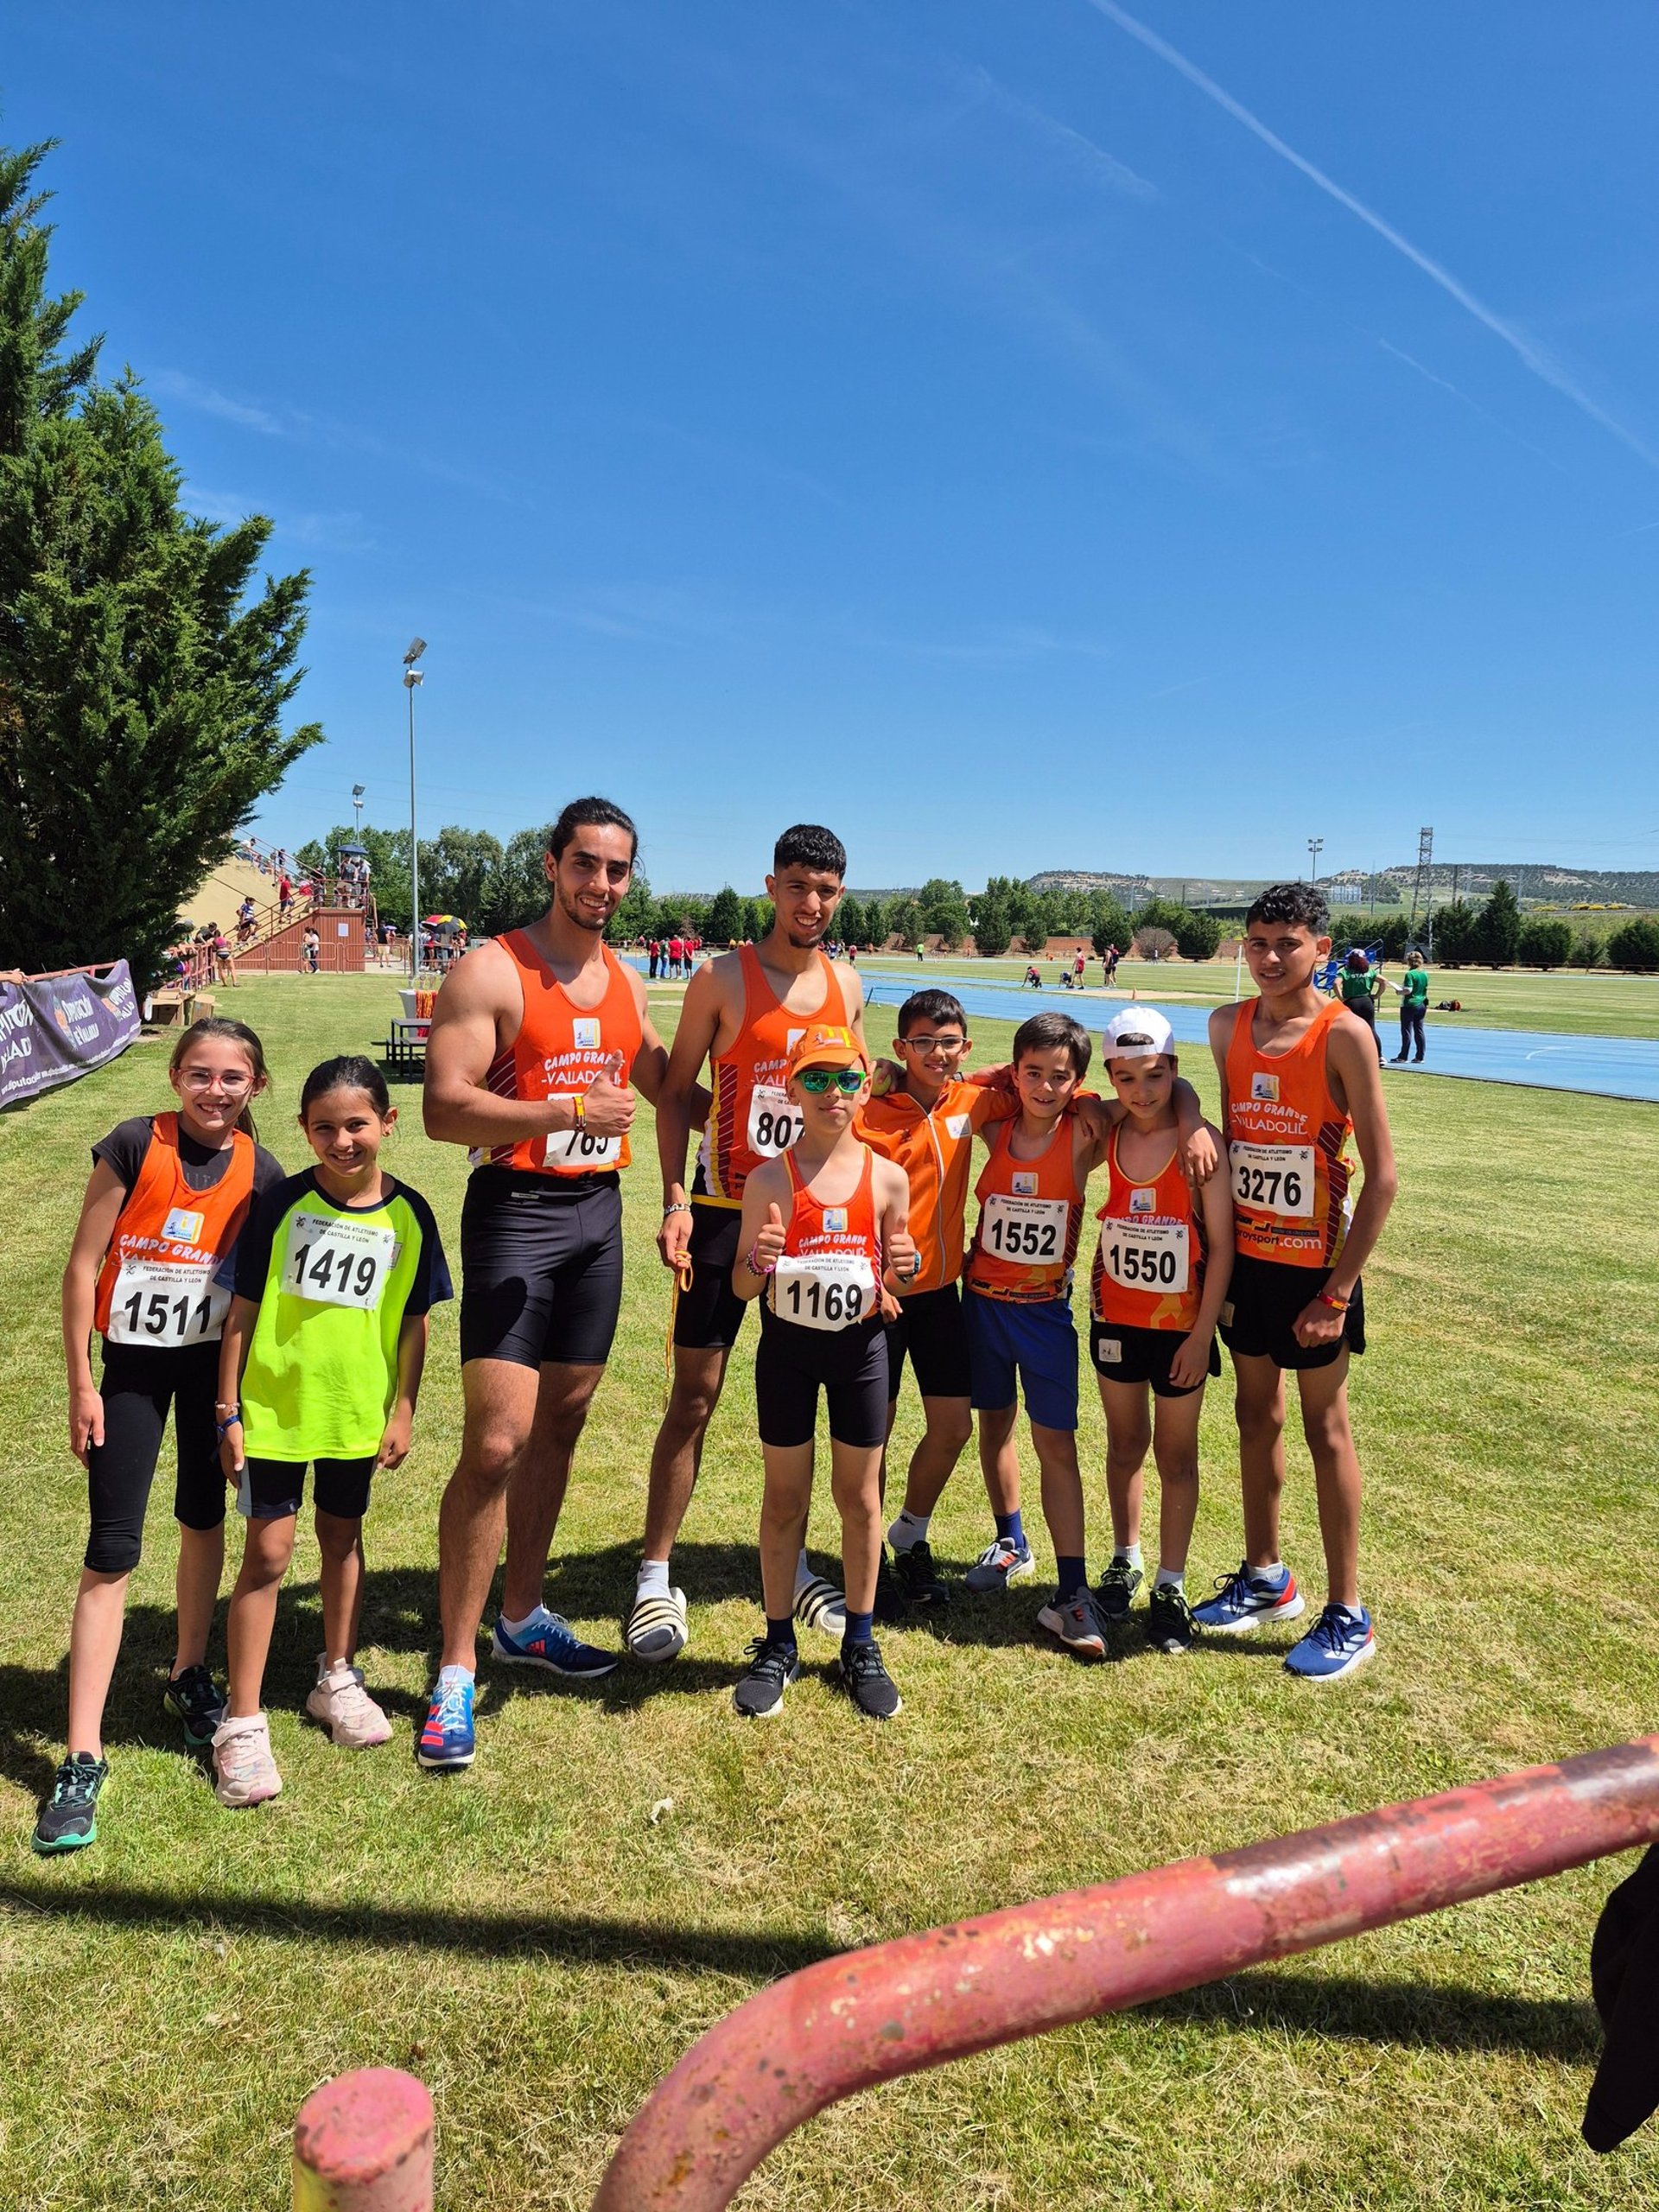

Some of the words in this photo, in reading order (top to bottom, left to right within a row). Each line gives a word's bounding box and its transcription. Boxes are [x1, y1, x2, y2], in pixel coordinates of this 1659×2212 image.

[544, 1051, 582, 1071] CAMPO
[753, 1059, 787, 1073] CAMP
[1231, 1102, 1261, 1114] CAMPO
[1263, 1103, 1308, 1123] GRANDE
[1236, 1166, 1301, 1206] 3276
[327, 1230, 350, 1240] CASTILLA
[352, 1227, 378, 1236] ATLETISMO
[798, 1234, 831, 1249] CAMPO
[833, 1233, 868, 1246] GRANDE
[991, 1218, 1057, 1256] 1552
[119, 1234, 170, 1253] CAMPO
[294, 1243, 377, 1297] 1419
[1109, 1244, 1176, 1284] 1550
[787, 1280, 862, 1321] 1169
[124, 1291, 212, 1336] 1511
